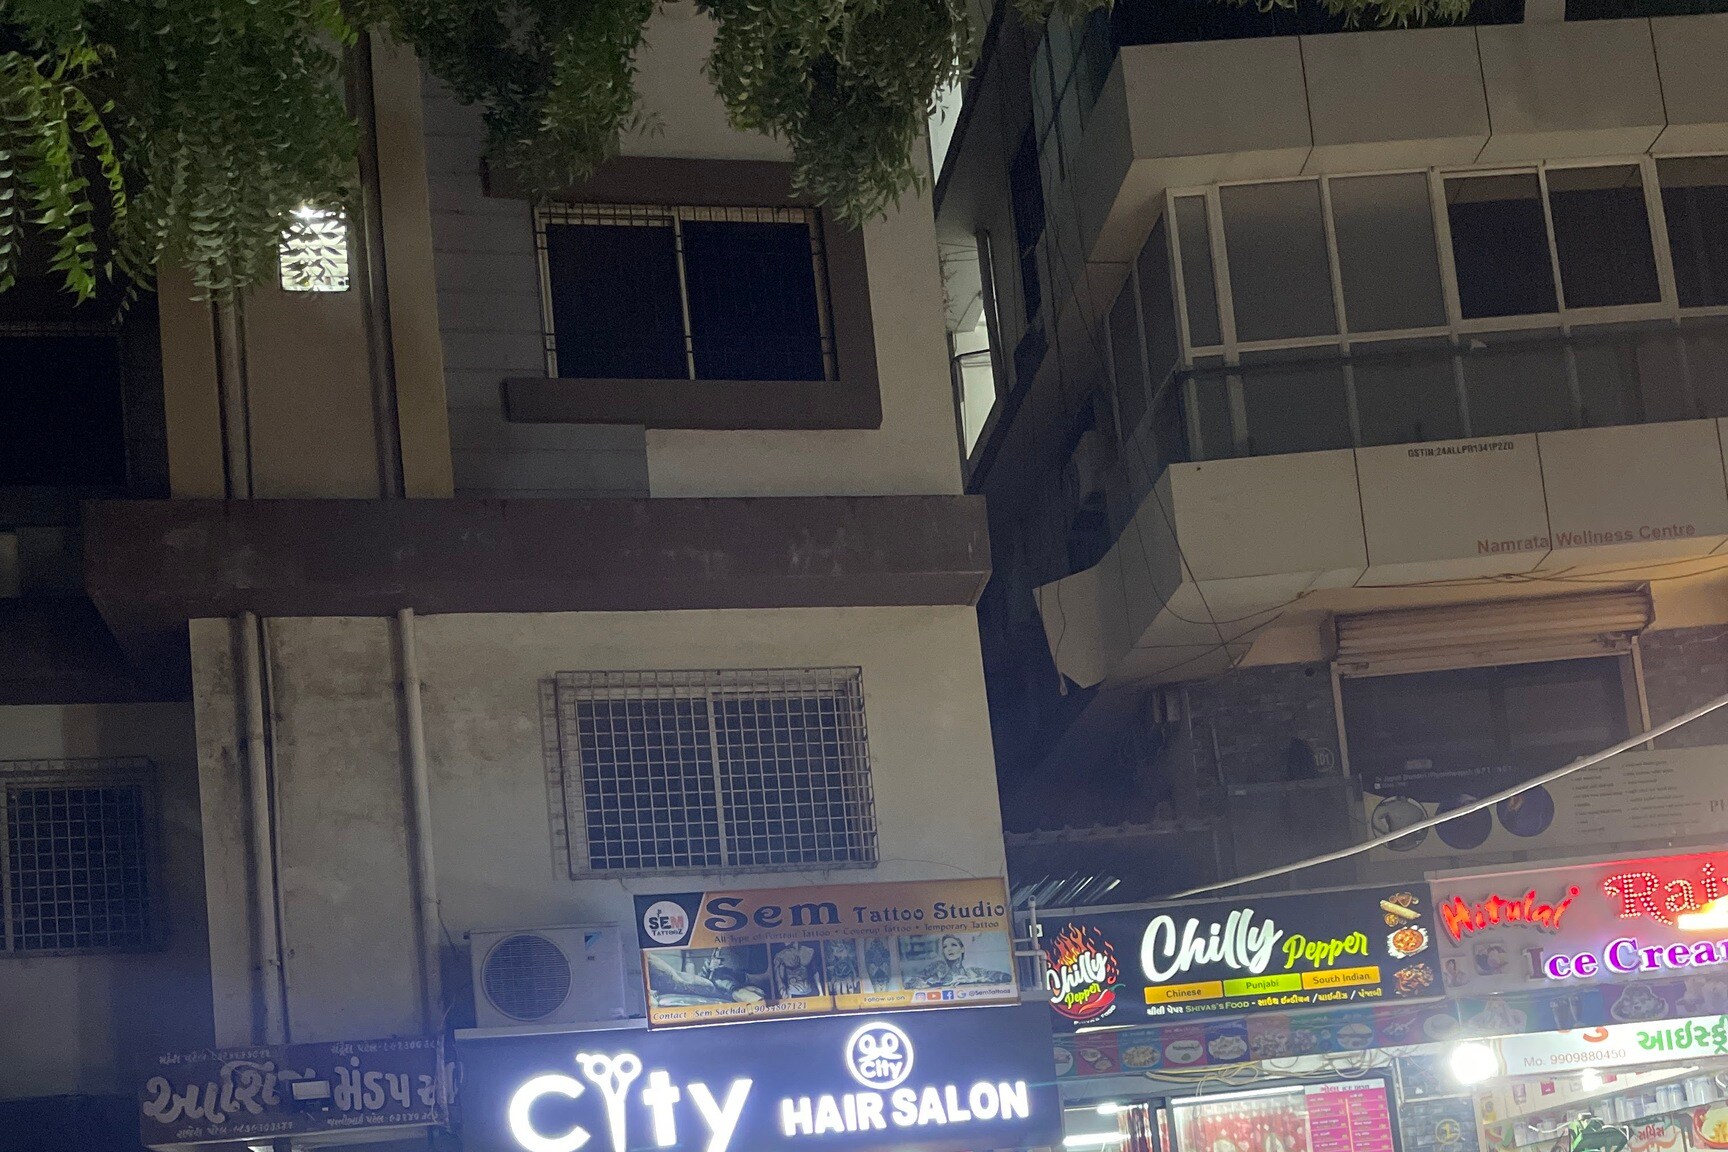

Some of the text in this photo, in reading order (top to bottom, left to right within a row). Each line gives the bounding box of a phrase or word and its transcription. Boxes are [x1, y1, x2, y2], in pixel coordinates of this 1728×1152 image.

[1477, 523, 1696, 554] Namrata Wellness Centre
[648, 915, 684, 930] SEM
[704, 896, 1005, 932] Sem Tattoo Studio
[714, 935, 727, 943] All
[765, 931, 798, 941] Portrait
[802, 928, 830, 938] Tattoo
[843, 927, 880, 936] Coverup
[884, 924, 911, 934] Tattoo
[924, 922, 967, 932] Temporary
[972, 920, 999, 929] Tattoo
[1141, 908, 1369, 982] Chilly Pepper
[1524, 936, 1728, 980] Ice Crea
[1046, 951, 1108, 1003] Chilly
[1246, 978, 1280, 990] Punjabi
[1312, 971, 1371, 985] South Indian
[1064, 982, 1102, 1010] Pepper
[1166, 987, 1202, 999] Chinese
[1225, 1000, 1250, 1010] FOOD
[653, 1011, 687, 1021] Contact
[694, 1009, 712, 1018] Sem
[1550, 1049, 1626, 1065] 9909880450
[333, 1056, 411, 1111] મંડપ
[782, 1080, 1030, 1138] HAIR SALON
